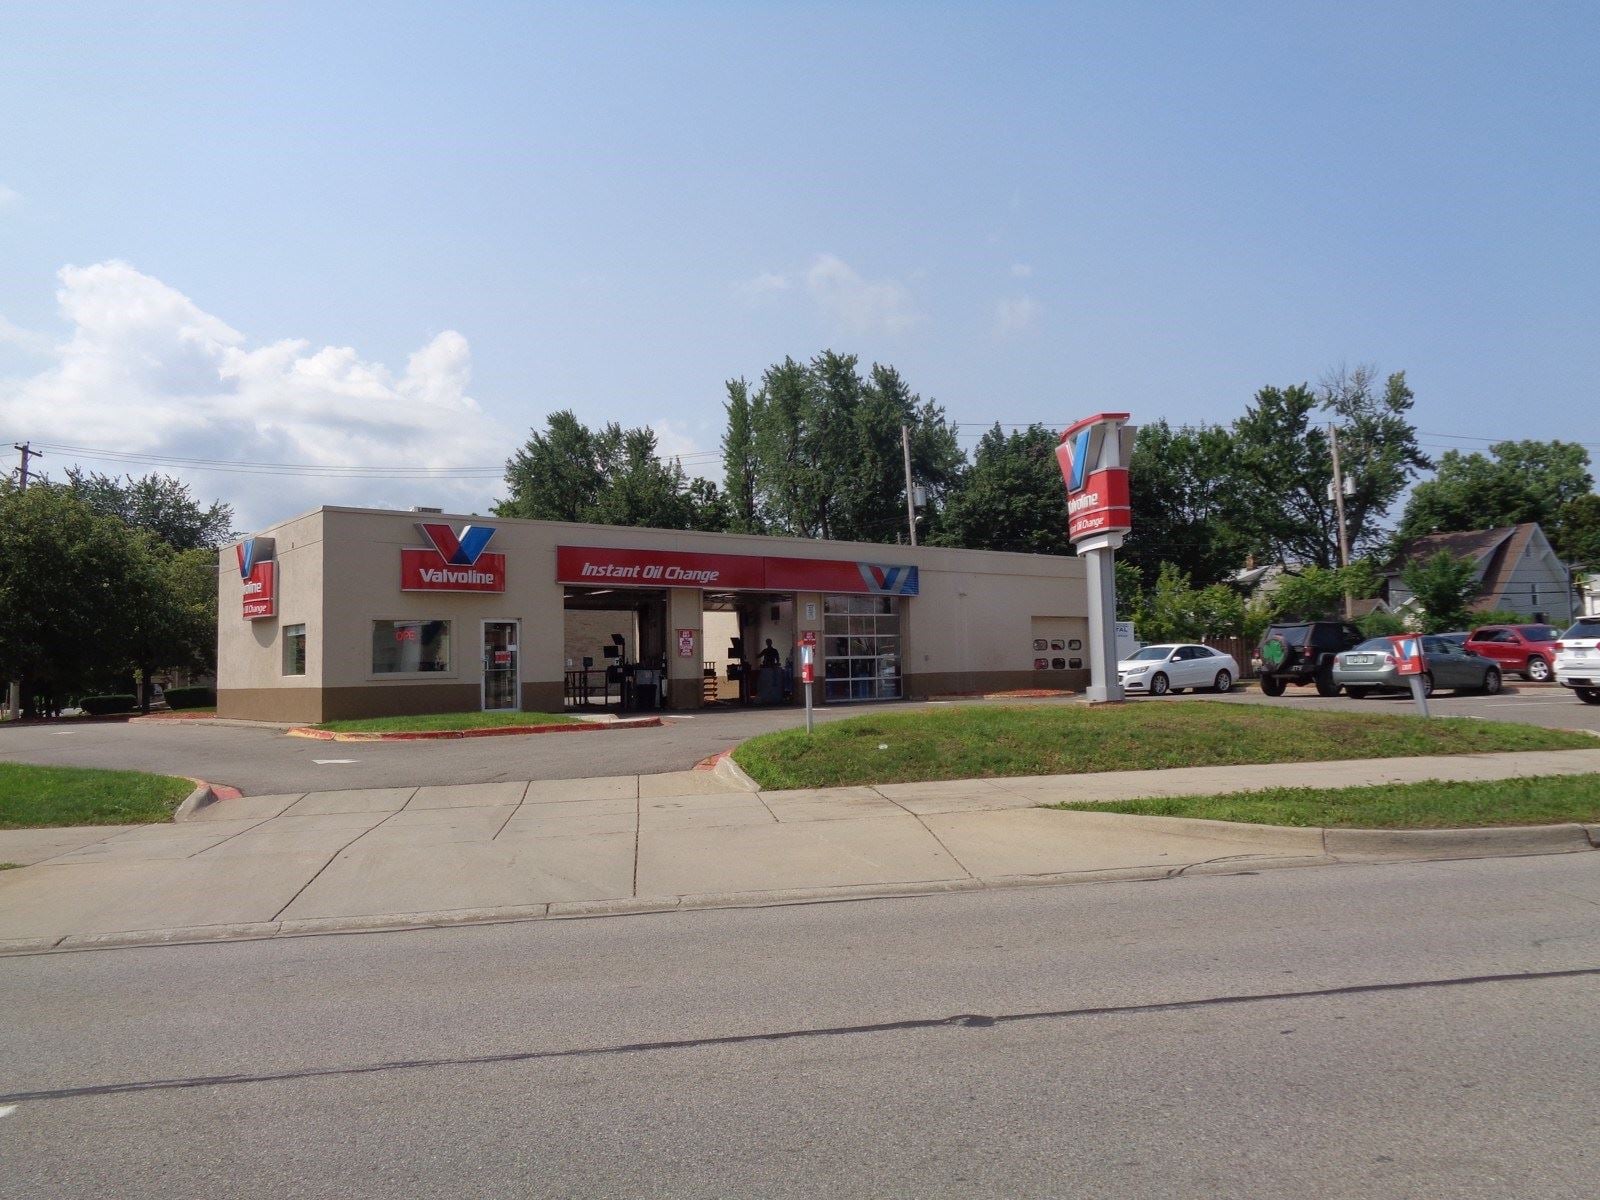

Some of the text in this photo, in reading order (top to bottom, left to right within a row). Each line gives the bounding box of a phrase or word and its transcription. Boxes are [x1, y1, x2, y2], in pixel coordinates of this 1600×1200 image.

[419, 568, 494, 585] Valvoline
[582, 562, 719, 583] Instant Oil Change
